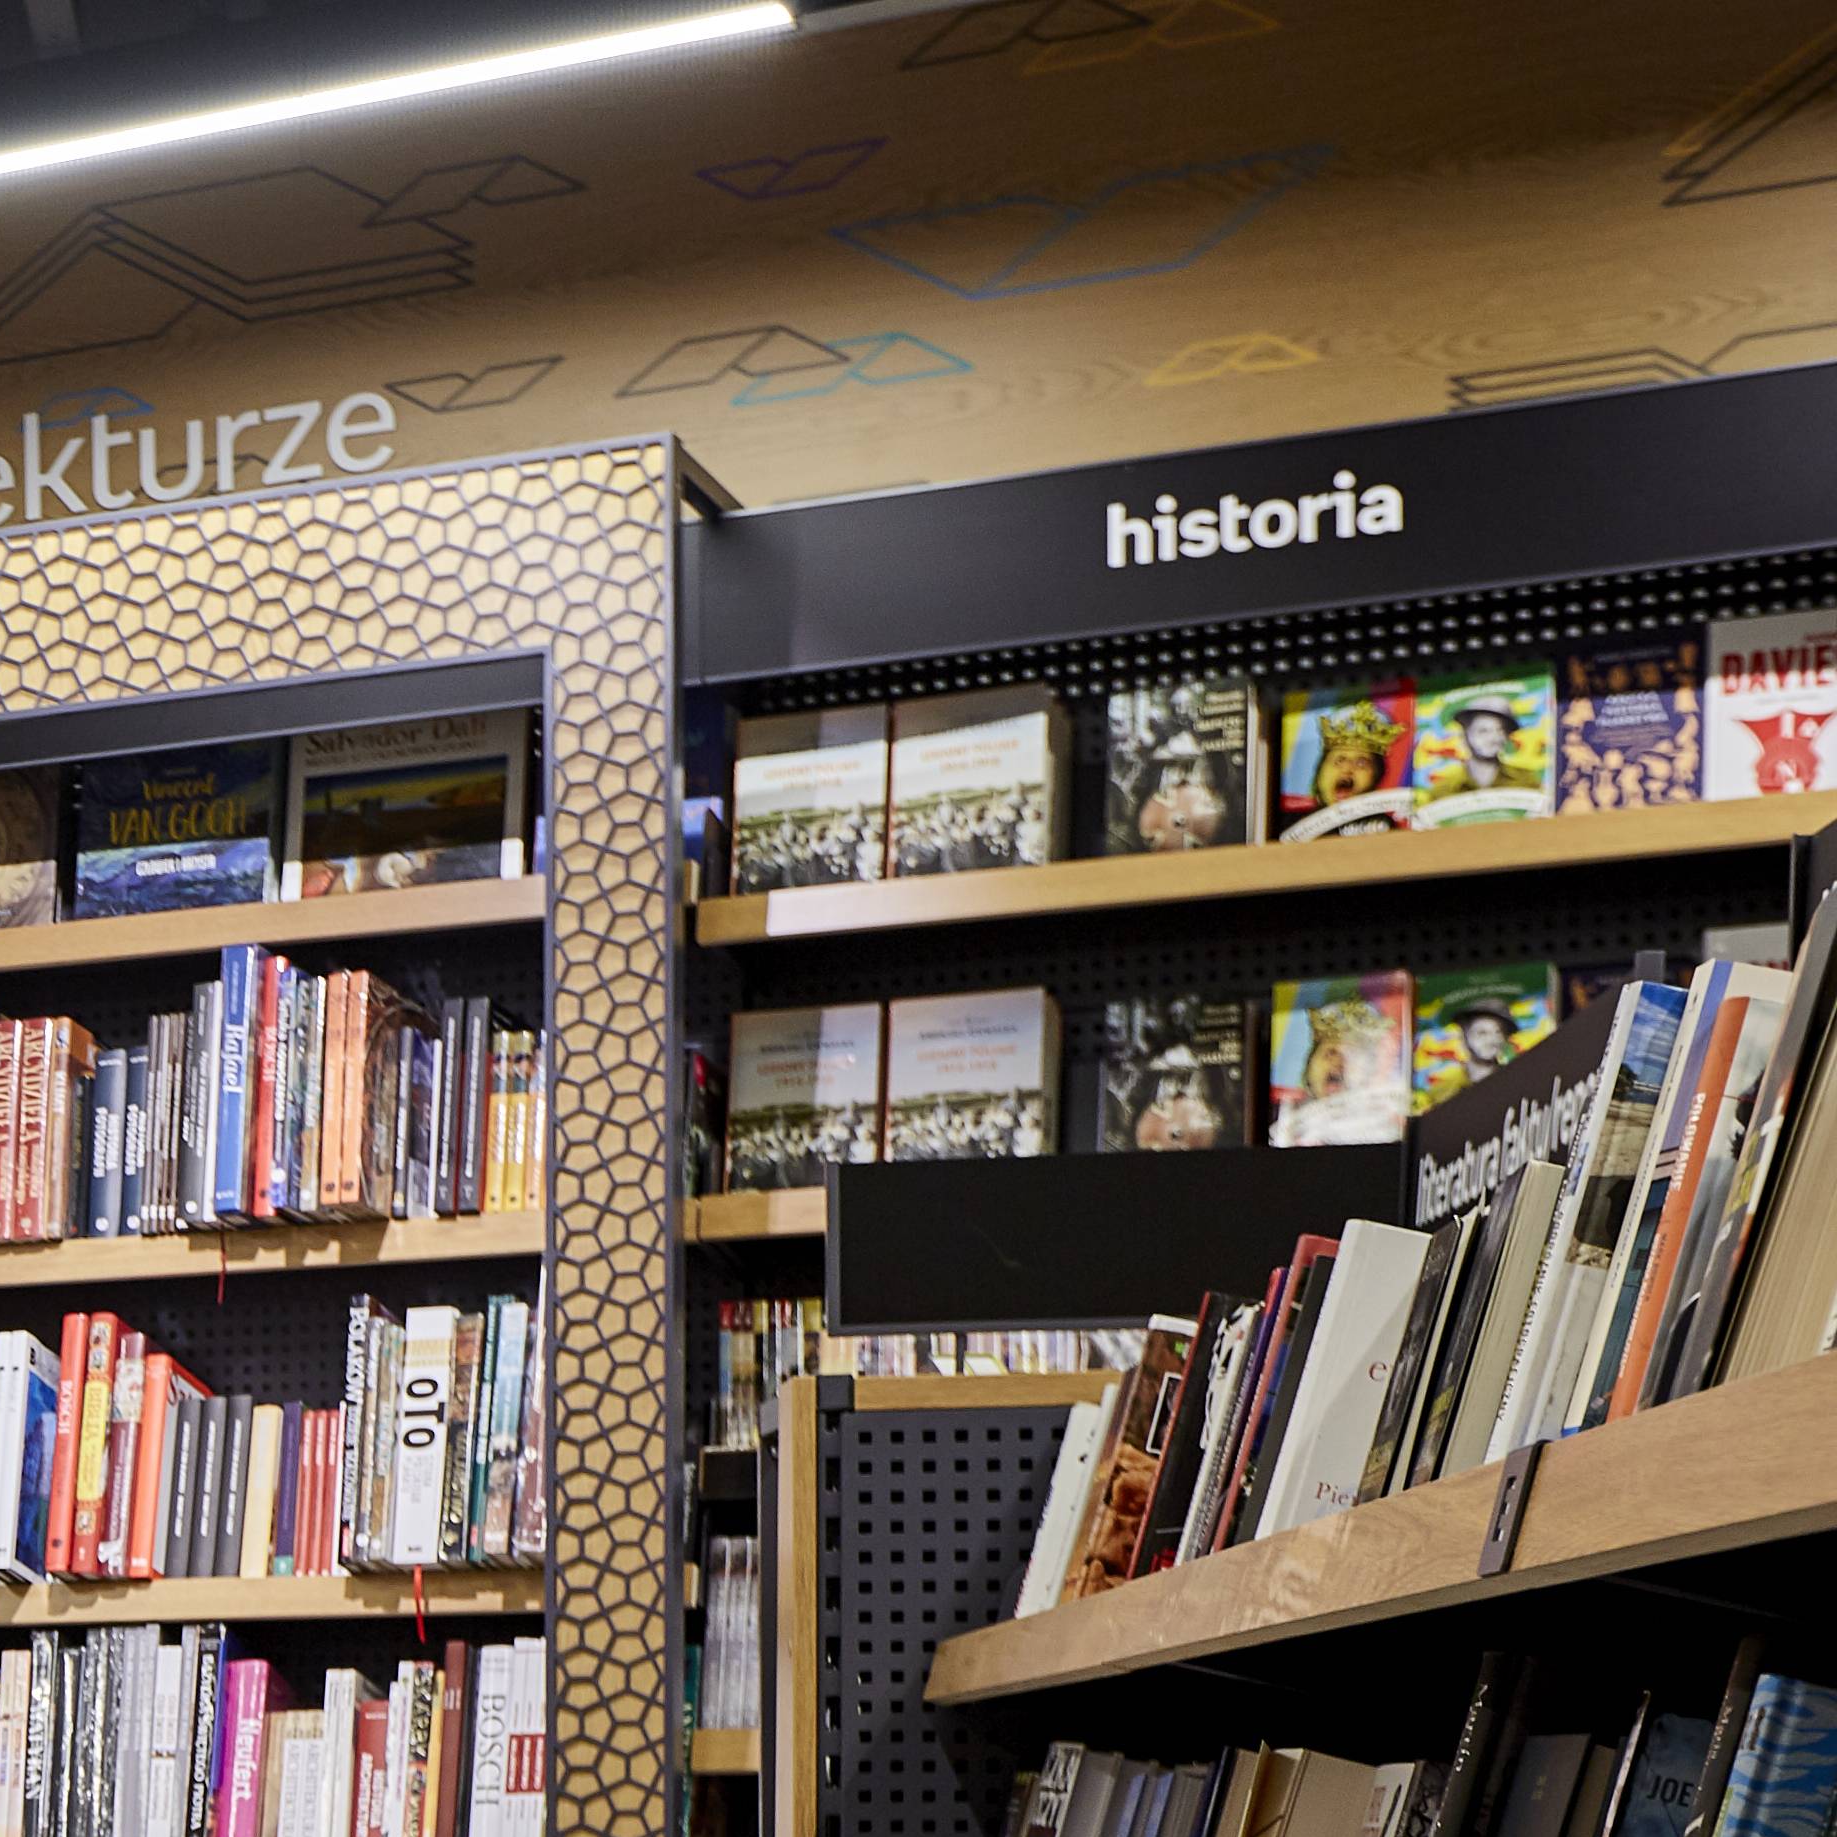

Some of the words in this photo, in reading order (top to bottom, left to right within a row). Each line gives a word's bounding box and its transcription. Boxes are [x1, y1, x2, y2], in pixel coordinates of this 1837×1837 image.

[1106, 470, 1405, 568] historia
[110, 807, 163, 845] VAN
[169, 801, 252, 839] GOGH
[142, 772, 215, 803] Vincent
[223, 1025, 245, 1093] Rafael
[1416, 1136, 1503, 1227] literatura
[1671, 1091, 1706, 1192] POLOWANIE
[235, 1717, 261, 1801] Neufert
[475, 1693, 506, 1806] BOSCH
[1645, 1773, 1697, 1810] JOE
